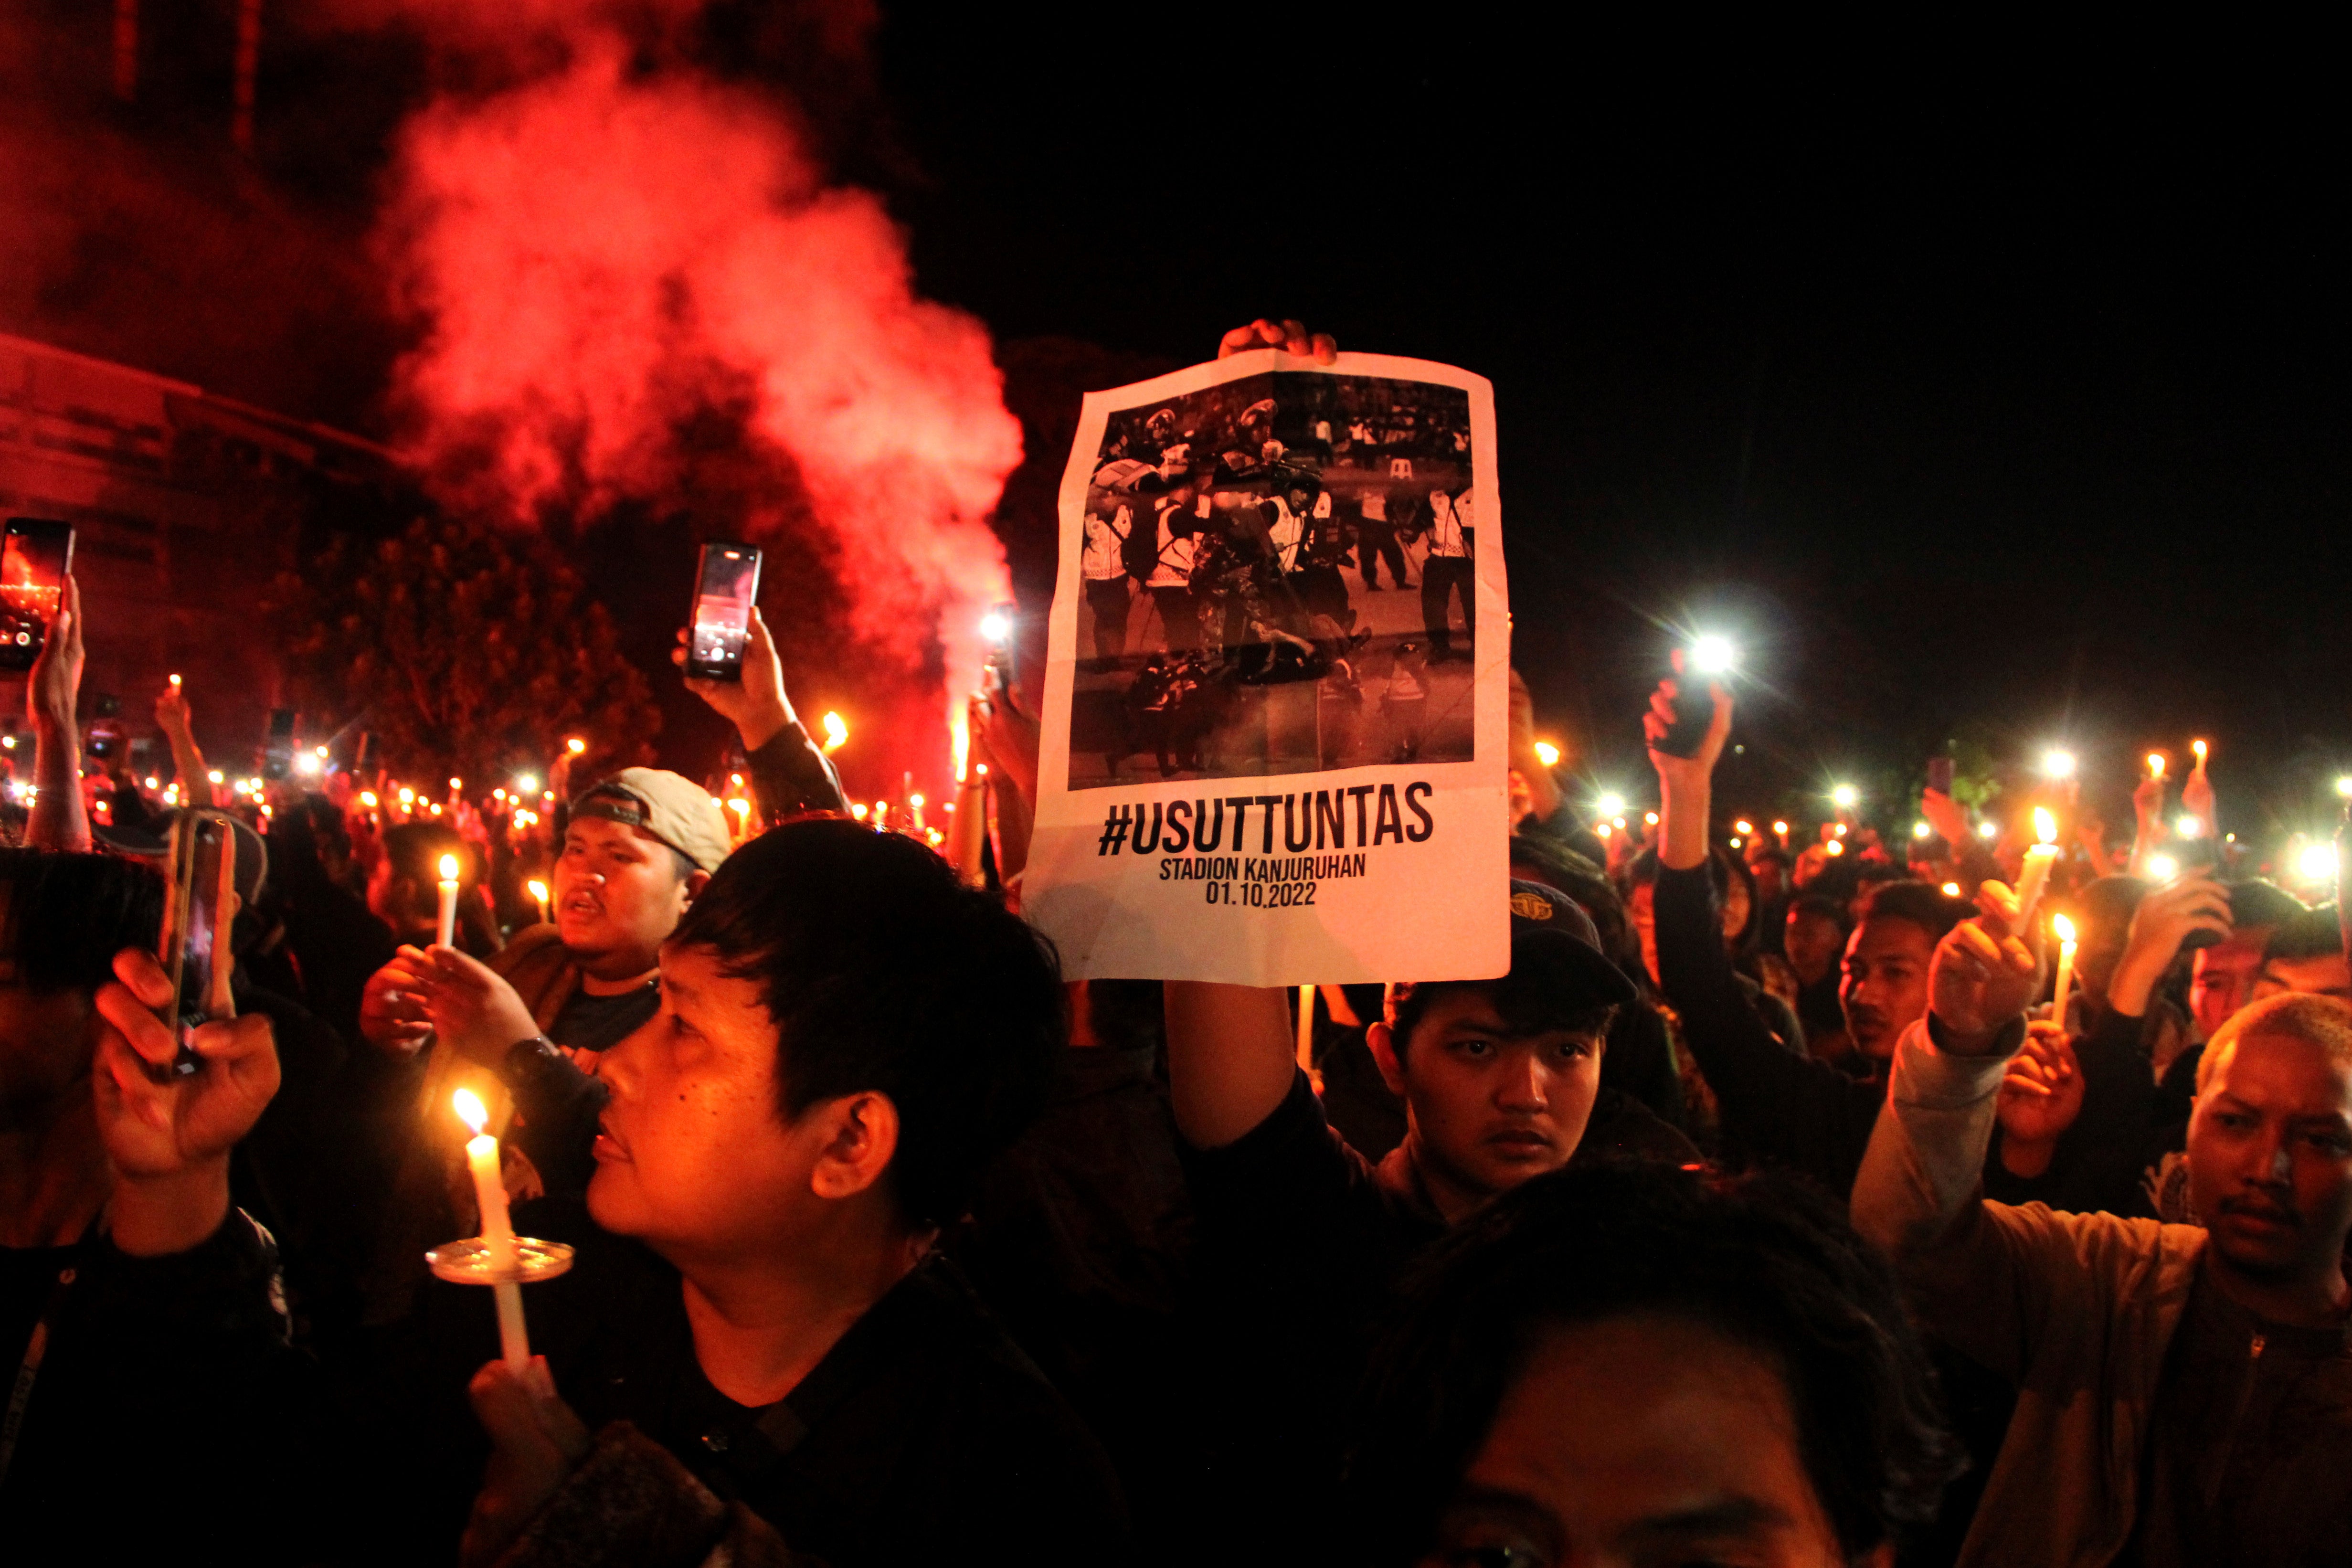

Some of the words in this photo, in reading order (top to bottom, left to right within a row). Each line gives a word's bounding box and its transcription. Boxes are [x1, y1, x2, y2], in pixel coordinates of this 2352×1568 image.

[1098, 781, 1434, 857] #USUTTUNTAS
[1159, 857, 1239, 881] STADION
[1244, 853, 1366, 883] KANJURUHAN
[1206, 880, 1317, 909] 01.10.2022
